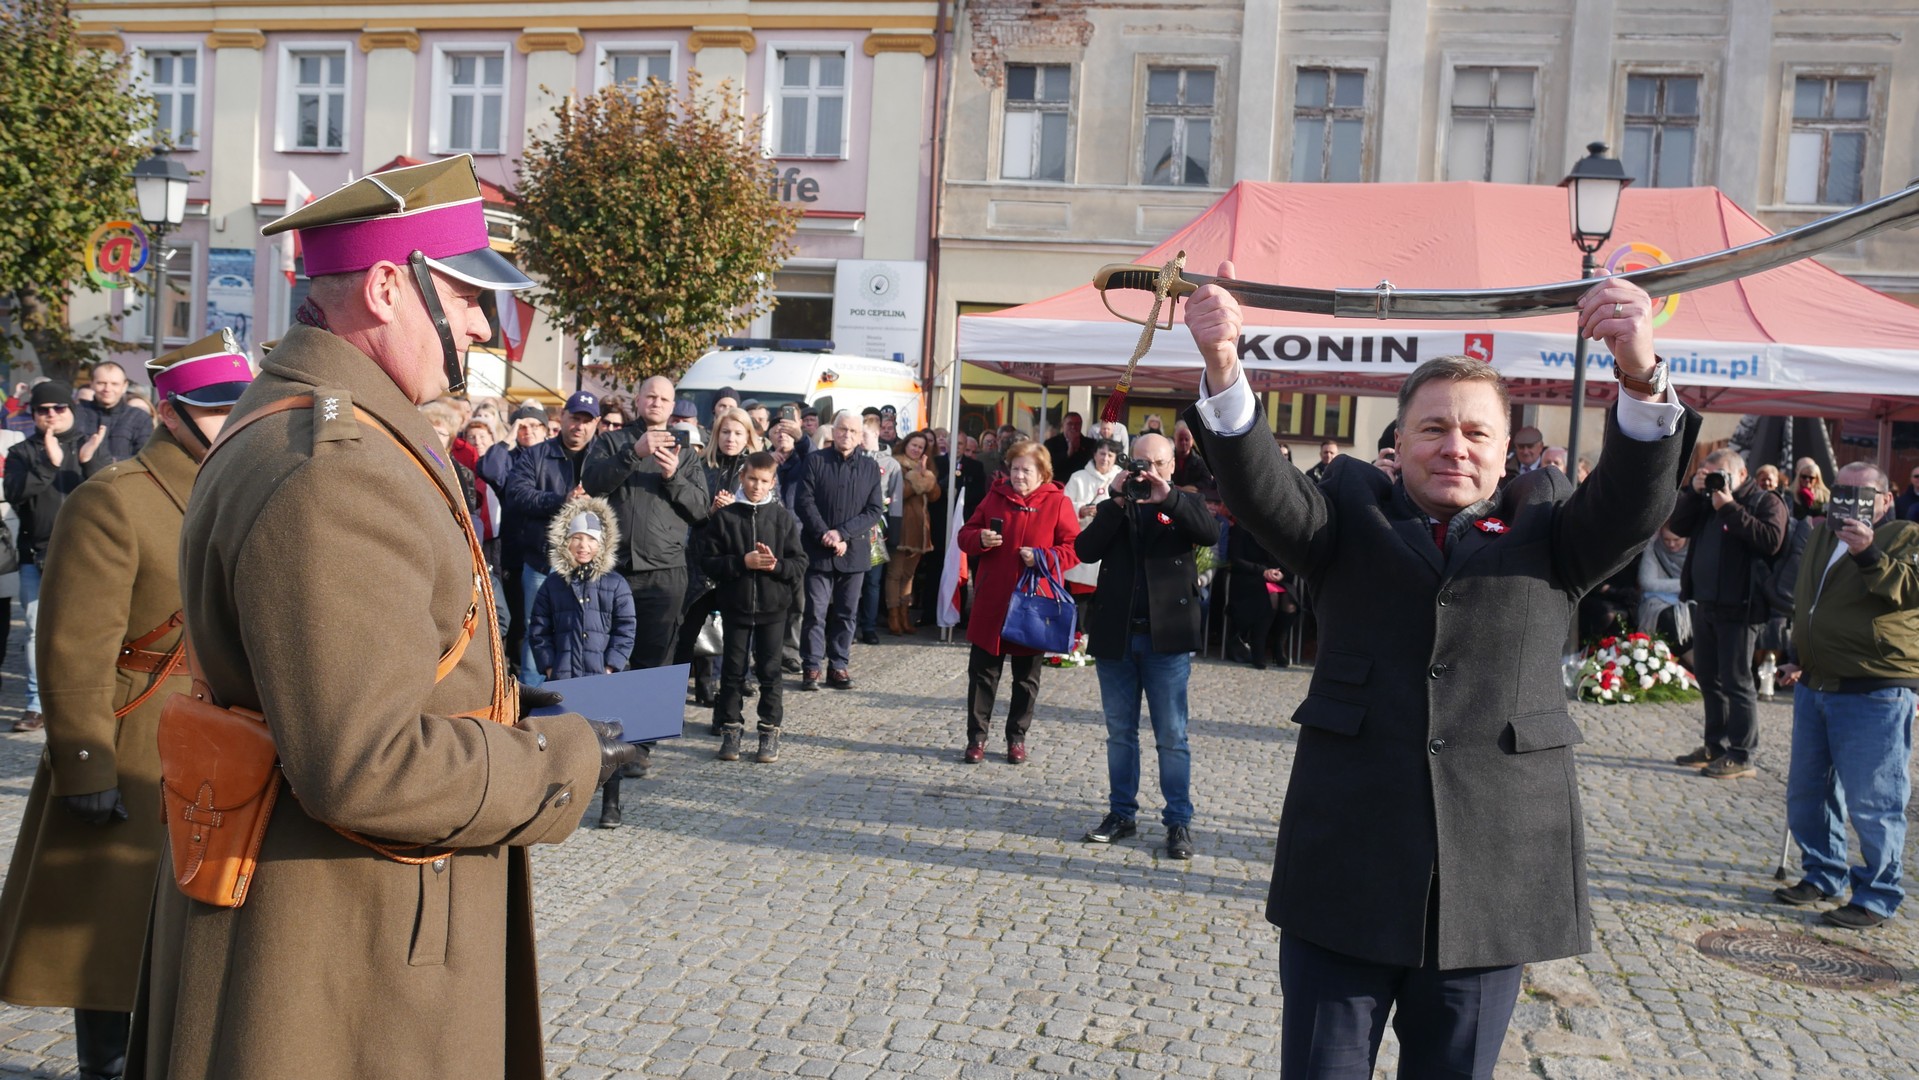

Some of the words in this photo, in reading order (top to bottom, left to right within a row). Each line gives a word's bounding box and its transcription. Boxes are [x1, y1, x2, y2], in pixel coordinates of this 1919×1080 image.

[766, 167, 820, 203] ife
[849, 308, 866, 316] POD
[1237, 334, 1419, 363] KONIN
